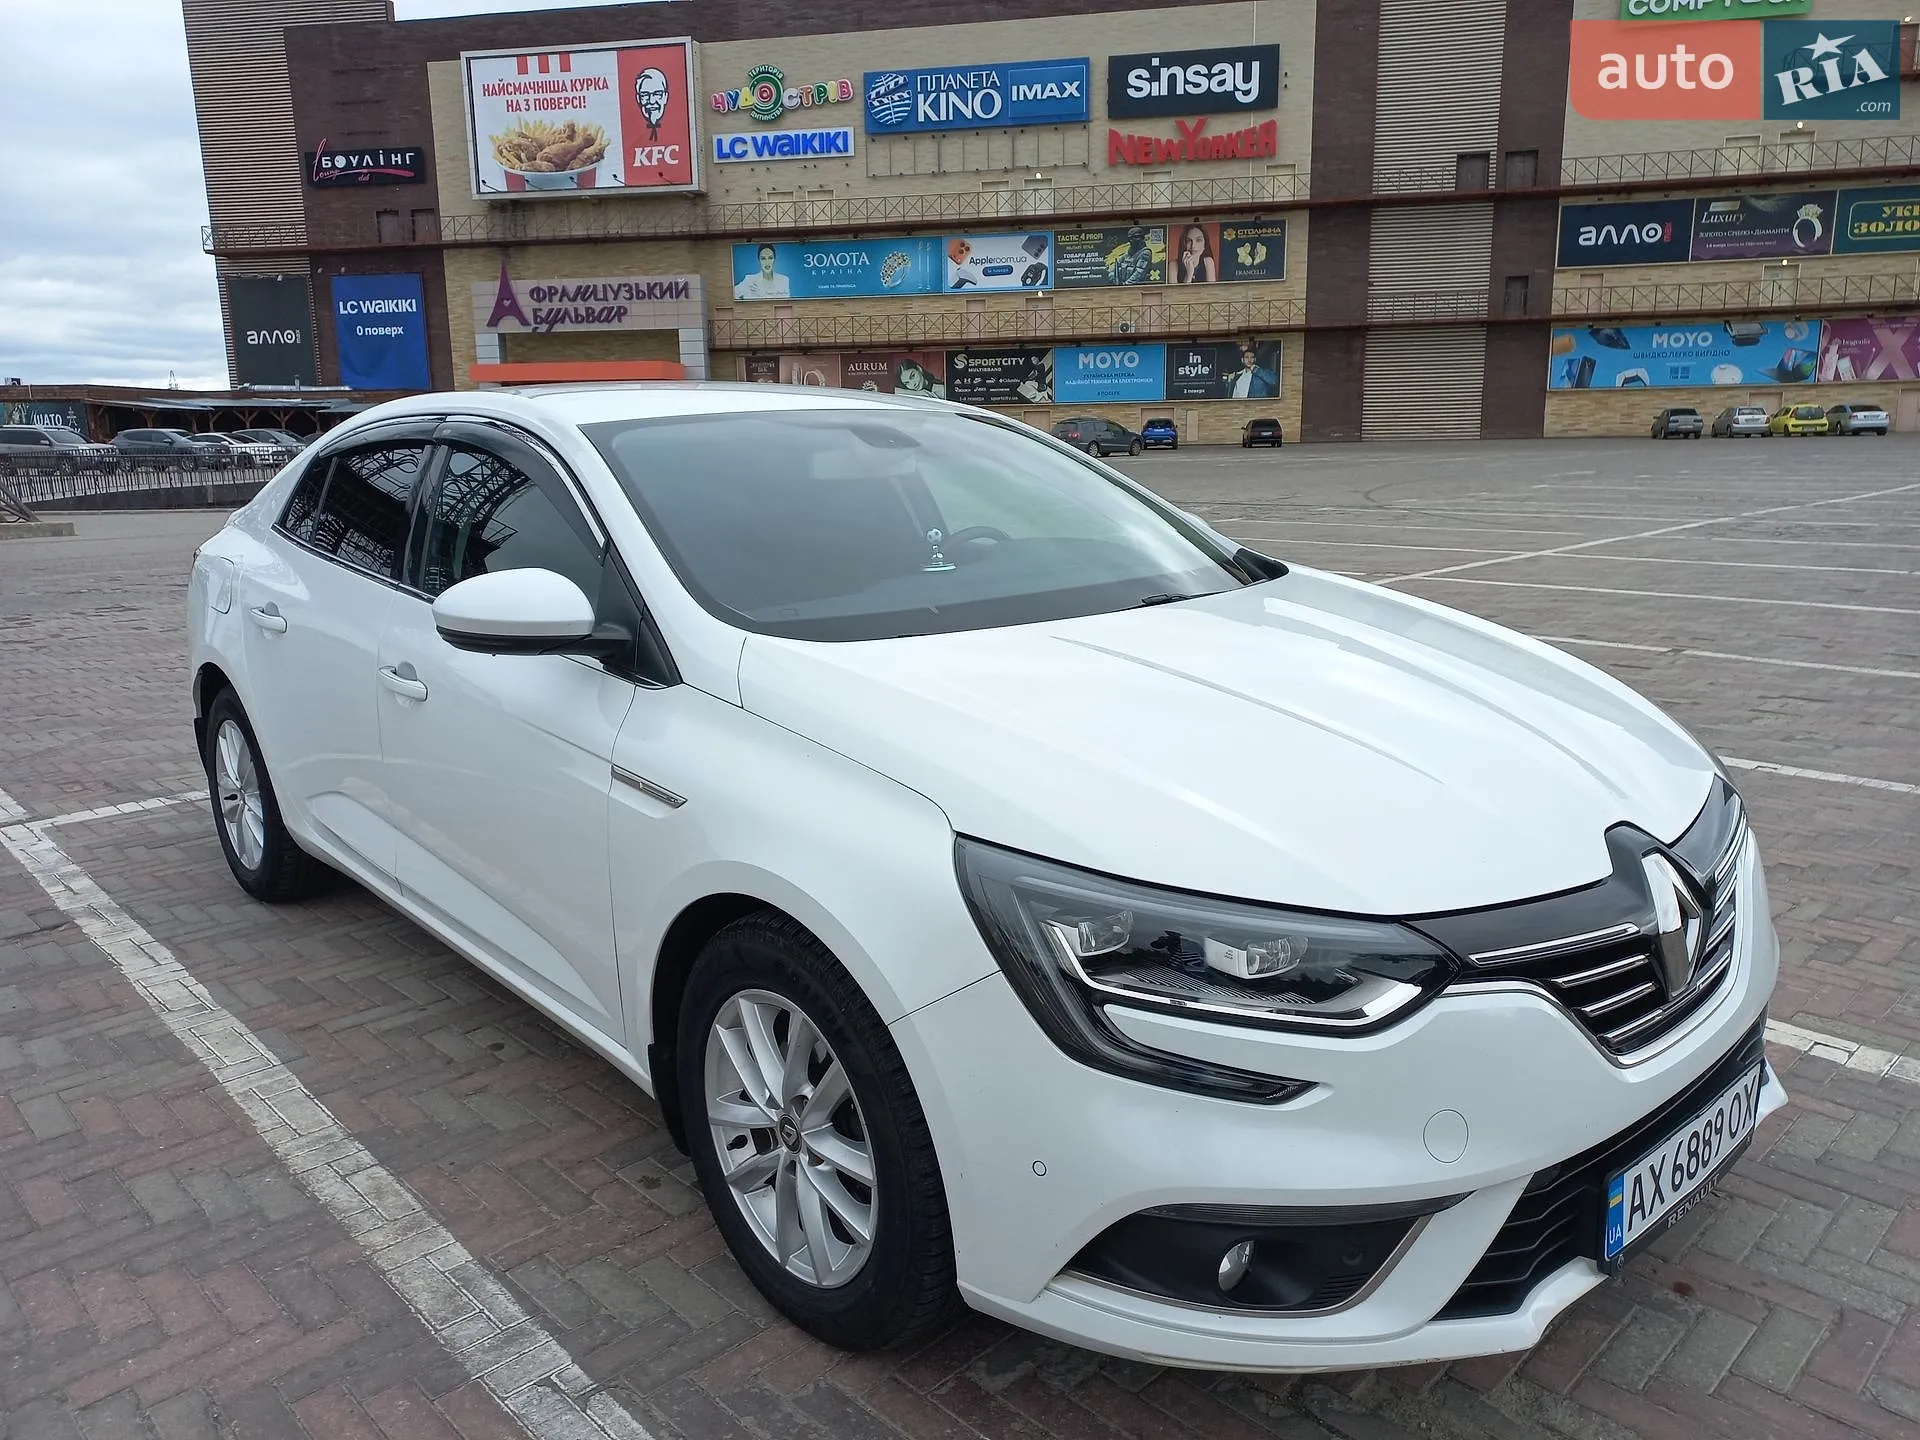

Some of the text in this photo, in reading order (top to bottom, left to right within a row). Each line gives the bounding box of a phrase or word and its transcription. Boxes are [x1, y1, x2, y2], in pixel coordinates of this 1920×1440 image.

[748, 65, 784, 80] ТЕРИТОРІЯ
[1126, 57, 1260, 104] sinsay
[482, 76, 609, 97] НАЙСМАЧНІША КУРКА
[1011, 81, 1081, 101] IMAX
[506, 95, 586, 113] НА 3 ПОВЕРСІ!
[917, 88, 1001, 122] KINO
[632, 145, 680, 167] KFC
[716, 136, 748, 159] LC
[1700, 211, 1747, 225] Luxury
[1057, 234, 1079, 242] TACTIC
[803, 251, 871, 268] ЗОЛОТА
[969, 255, 1027, 266] Appleroom.ua
[339, 301, 358, 315] LC
[356, 325, 404, 337] 0 поверх
[1652, 331, 1713, 349] MOYO
[1078, 351, 1140, 369] MOYO
[1188, 352, 1202, 364] in
[847, 362, 888, 372] AURUM
[1667, 1173, 1720, 1229] RENAULT
[1608, 1228, 1622, 1244] UA
